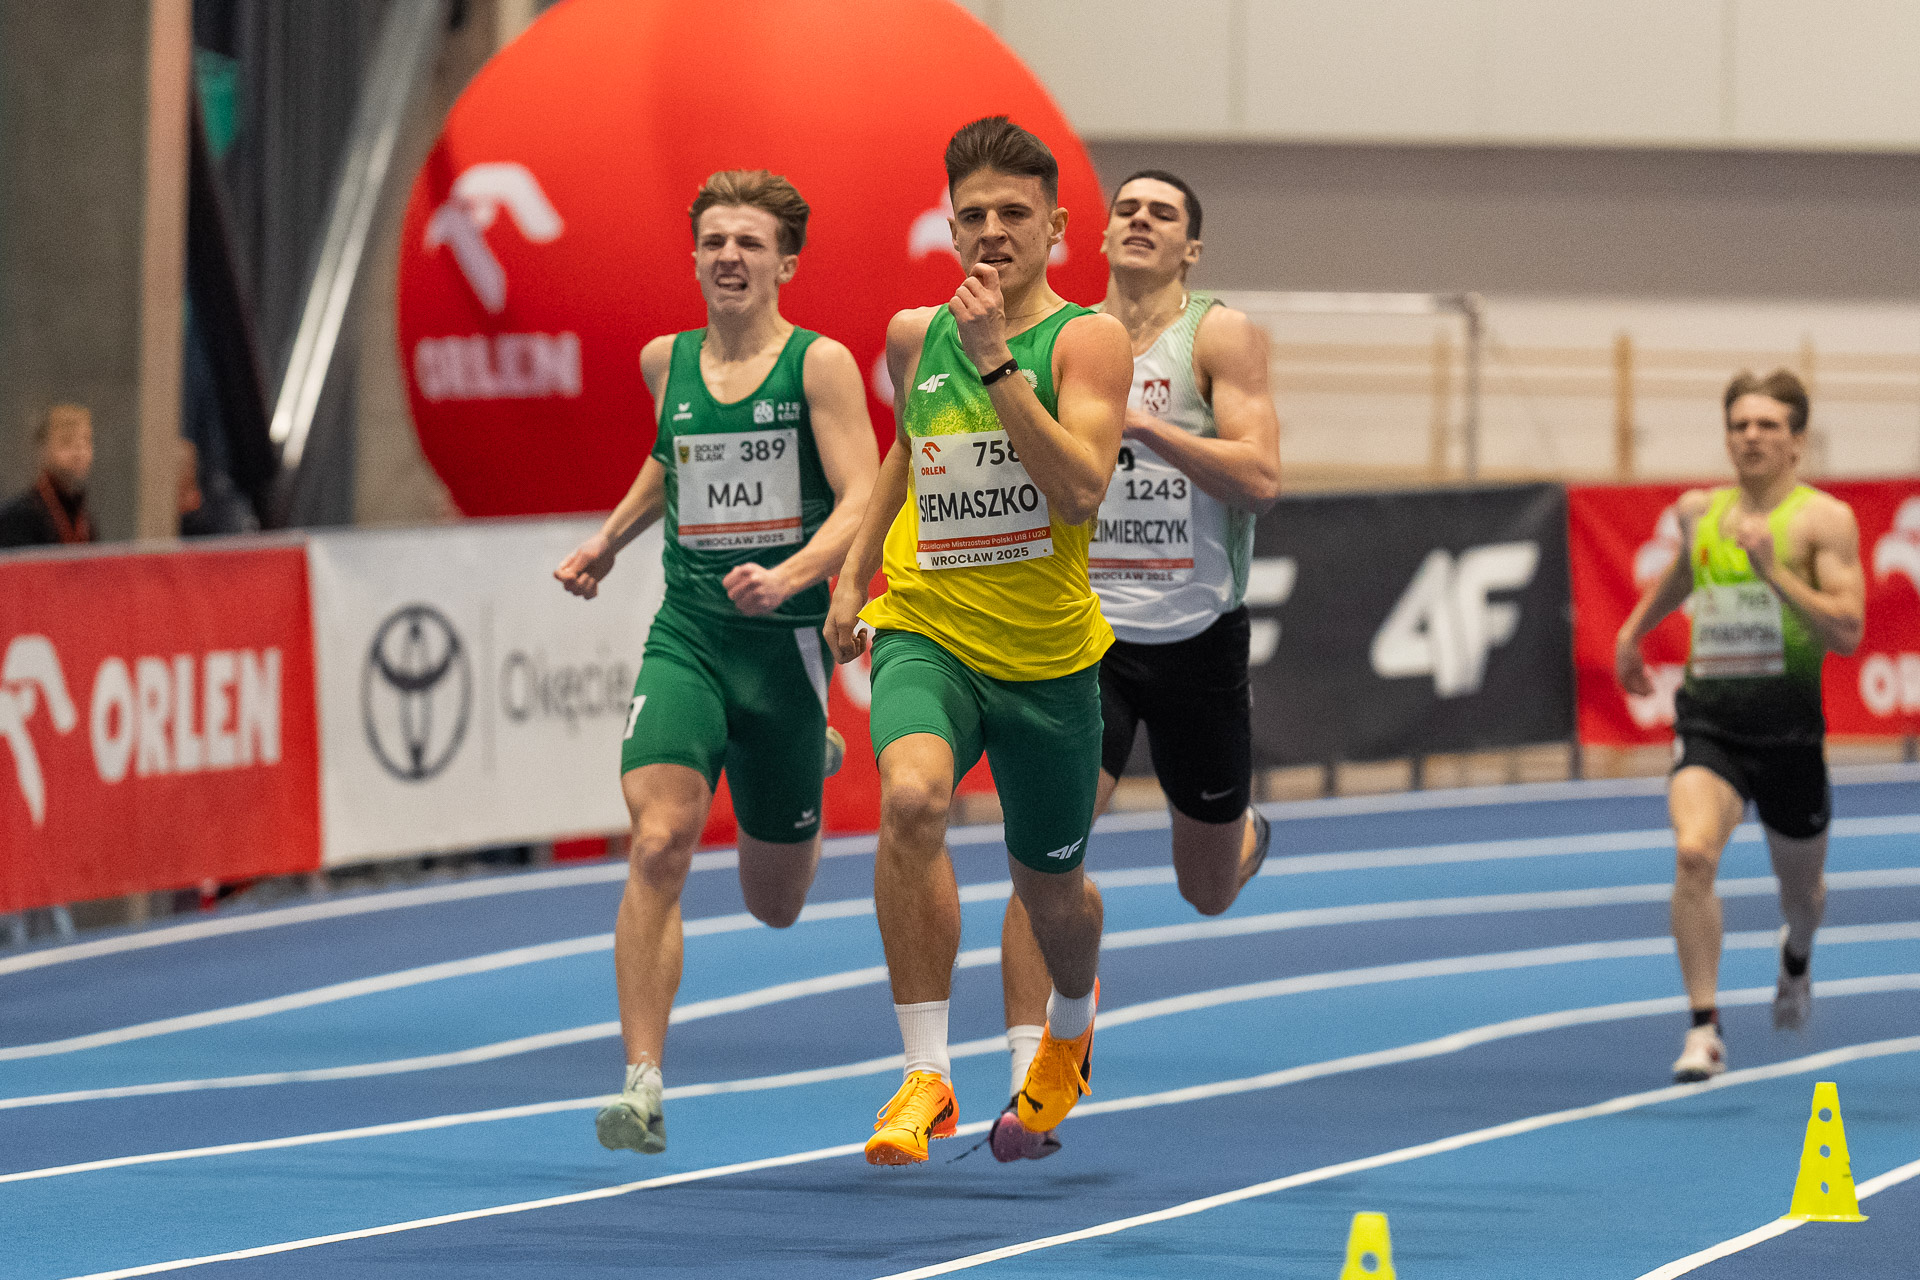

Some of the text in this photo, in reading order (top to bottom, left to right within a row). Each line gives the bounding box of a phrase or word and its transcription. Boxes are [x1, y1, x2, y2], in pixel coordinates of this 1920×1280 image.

[414, 330, 583, 402] ORLEN
[917, 373, 950, 394] 4F
[740, 437, 786, 462] 389
[921, 465, 946, 476] ORLEN
[707, 481, 763, 508] MAJ
[1125, 478, 1187, 501] 1243
[919, 484, 1039, 523] SIEMASZKO
[951, 539, 991, 549] Mistrzostwa
[991, 536, 1013, 545] Polski
[1014, 533, 1027, 542] U18
[1032, 530, 1047, 539] U20
[930, 547, 1030, 567] WROCŁAW 2025
[1369, 540, 1541, 699] 4F
[90, 647, 284, 784] ORLEN
